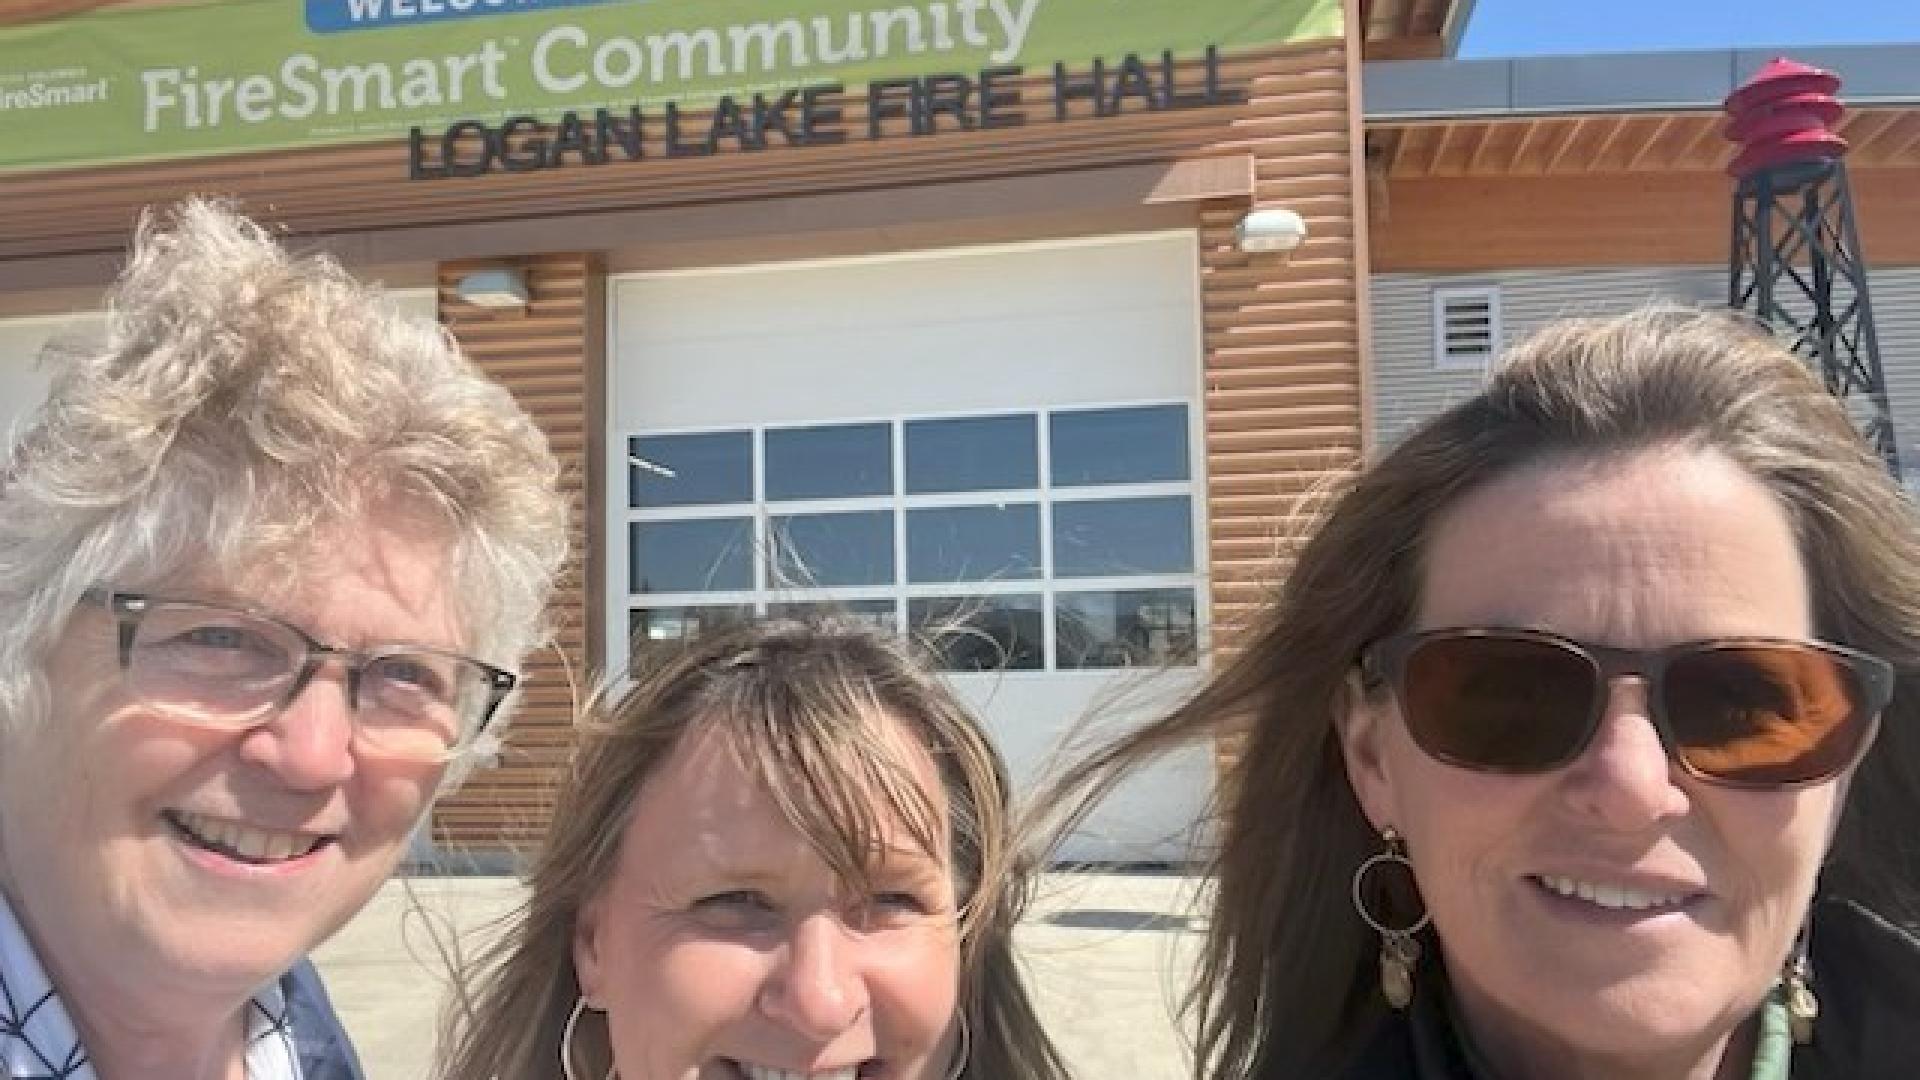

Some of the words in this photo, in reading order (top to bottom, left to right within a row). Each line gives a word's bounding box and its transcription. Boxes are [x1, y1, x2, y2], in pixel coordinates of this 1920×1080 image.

[140, 38, 508, 133] FireSmart
[532, 0, 1039, 93] Community
[409, 105, 643, 180] LOGAN
[666, 83, 845, 158] LAKE
[867, 65, 1025, 140] FIRE
[1054, 44, 1249, 122] HALL
